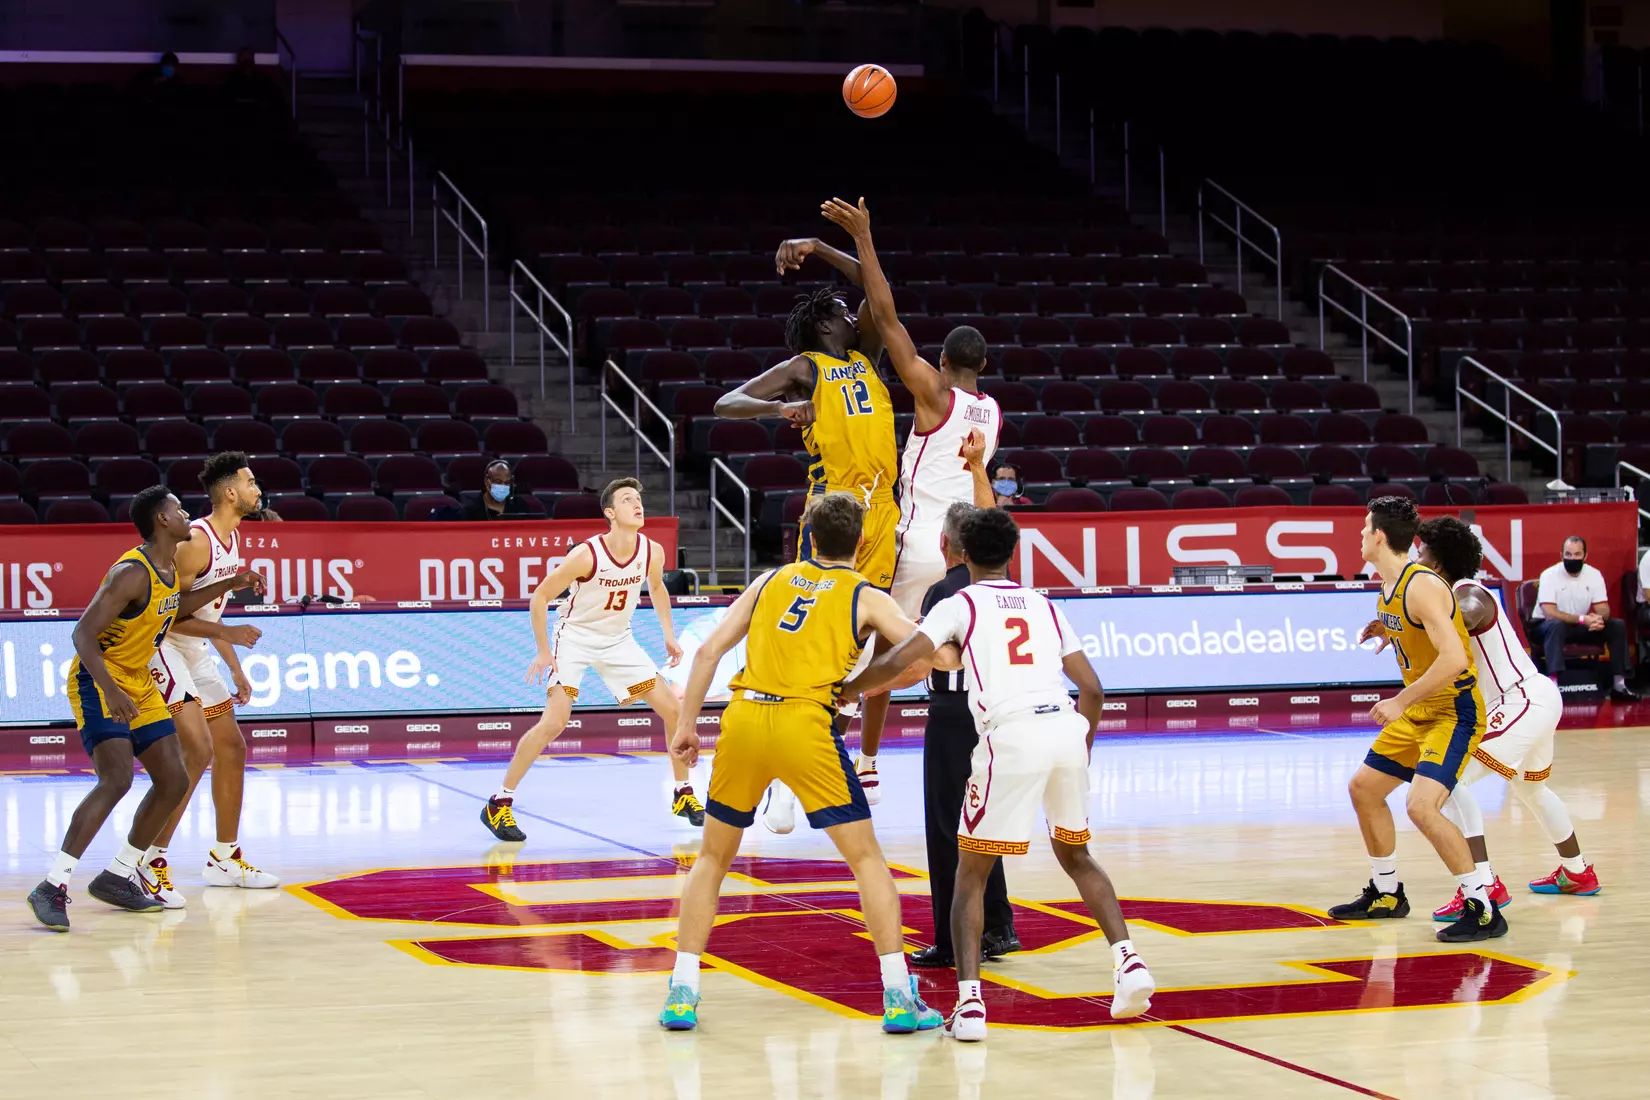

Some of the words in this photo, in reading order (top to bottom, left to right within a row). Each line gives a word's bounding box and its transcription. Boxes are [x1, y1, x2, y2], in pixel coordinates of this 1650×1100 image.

[840, 379, 873, 416] 12
[491, 536, 574, 548] CERVEZA
[420, 557, 505, 601] DOS
[598, 574, 642, 588] TROJANS
[604, 590, 629, 612] 13
[995, 595, 1027, 610] EADDY
[245, 604, 279, 613] GEICO
[777, 595, 818, 634] 5
[1004, 616, 1035, 667] 2
[241, 650, 441, 708] game.
[406, 723, 441, 733] GEICO
[477, 722, 512, 731] GEICO
[617, 718, 651, 726] GEICO
[252, 729, 287, 738] GEICO
[334, 725, 369, 735] GEICO
[30, 735, 66, 745] GEICO
